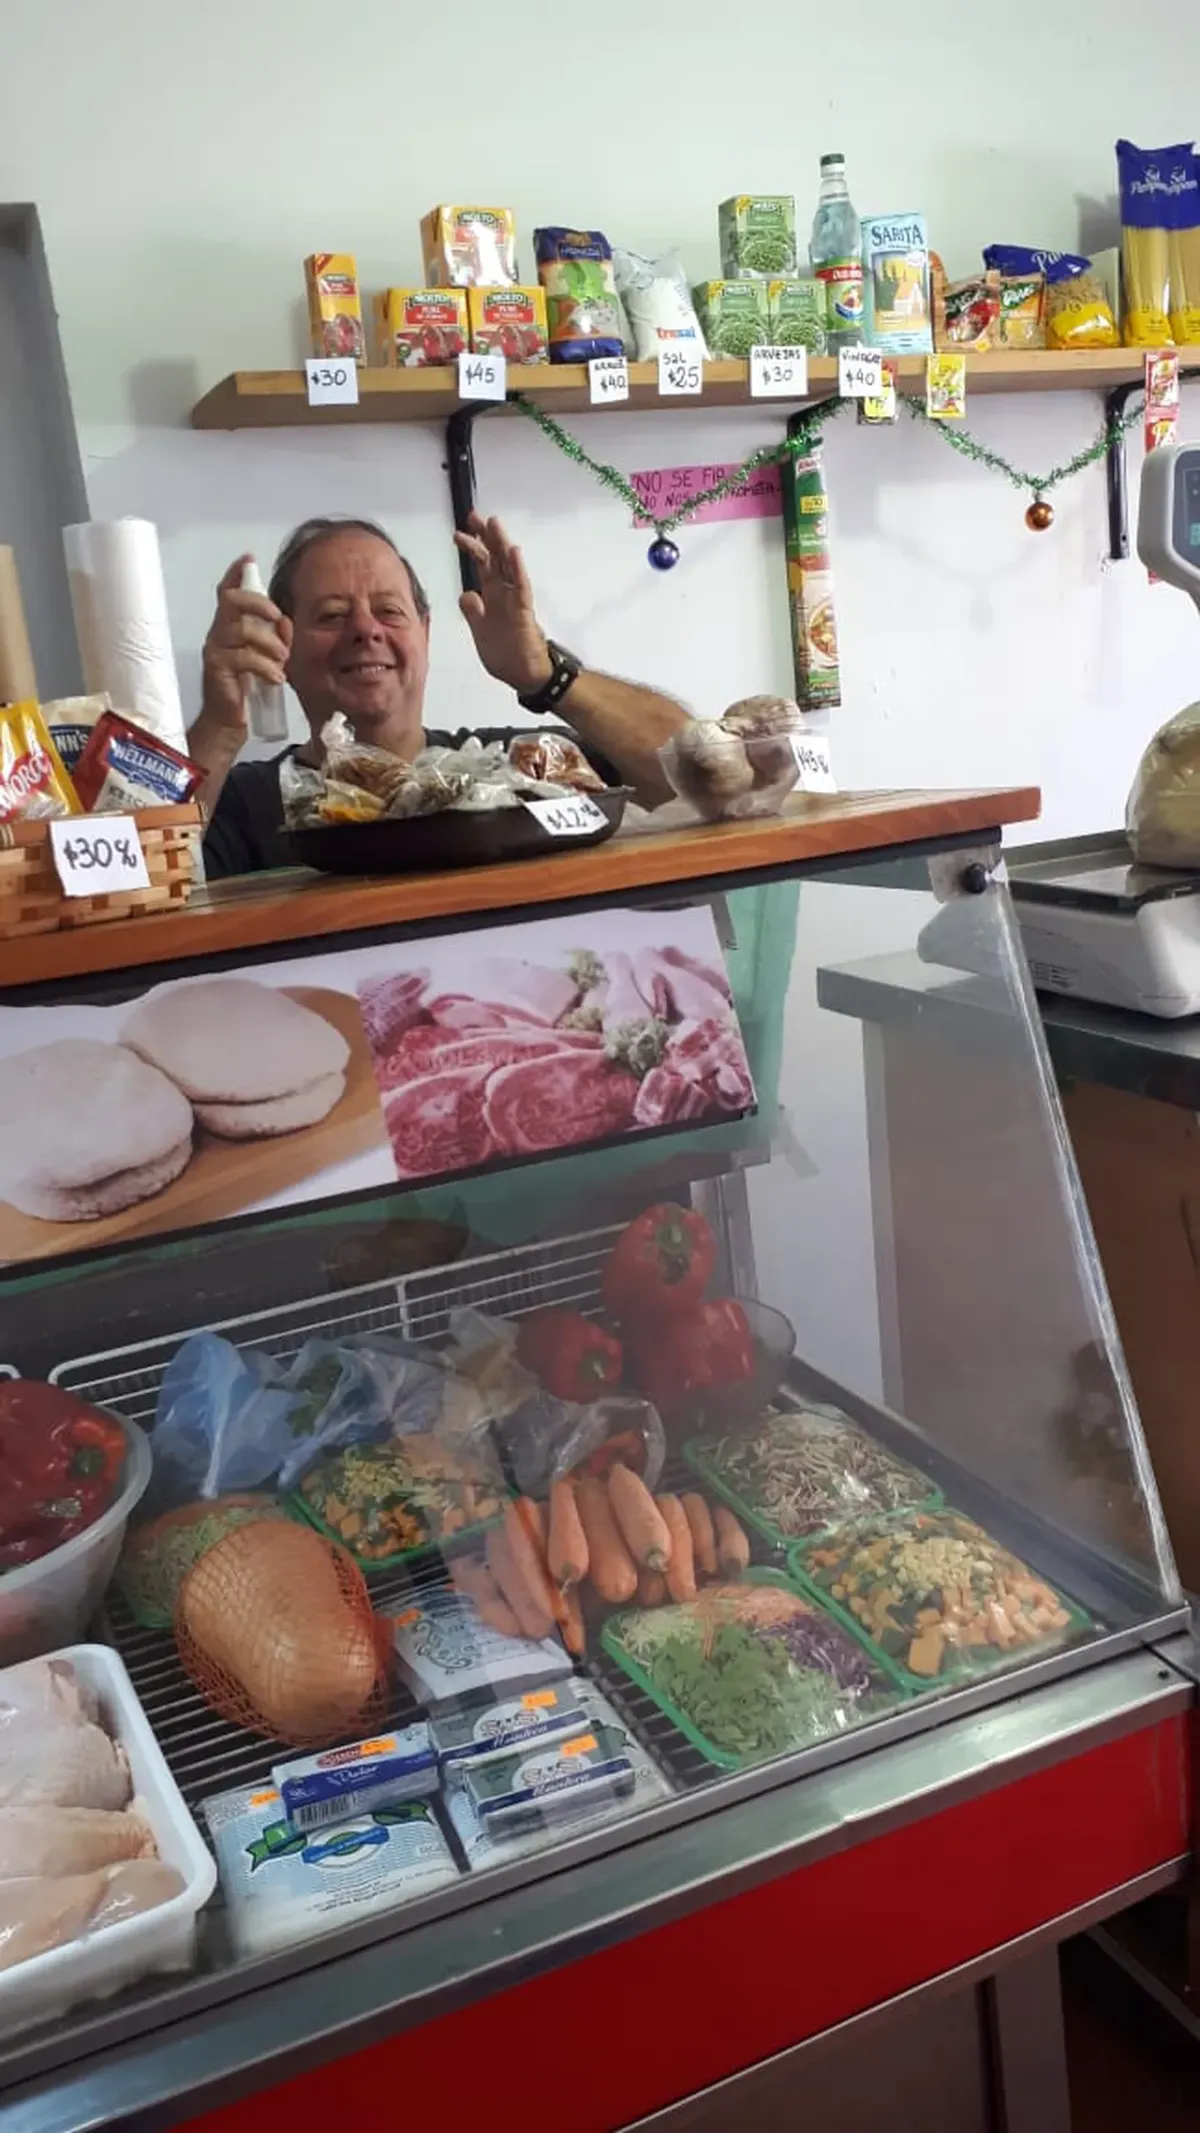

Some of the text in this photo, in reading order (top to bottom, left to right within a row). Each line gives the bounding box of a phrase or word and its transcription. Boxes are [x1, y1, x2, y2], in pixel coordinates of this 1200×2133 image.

[871, 223, 924, 247] SARITA
[310, 369, 348, 386] $30
[667, 366, 700, 389] $25
[762, 365, 794, 386] $30
[845, 368, 876, 388] $40
[635, 471, 662, 493] NO
[670, 469, 694, 487] SE
